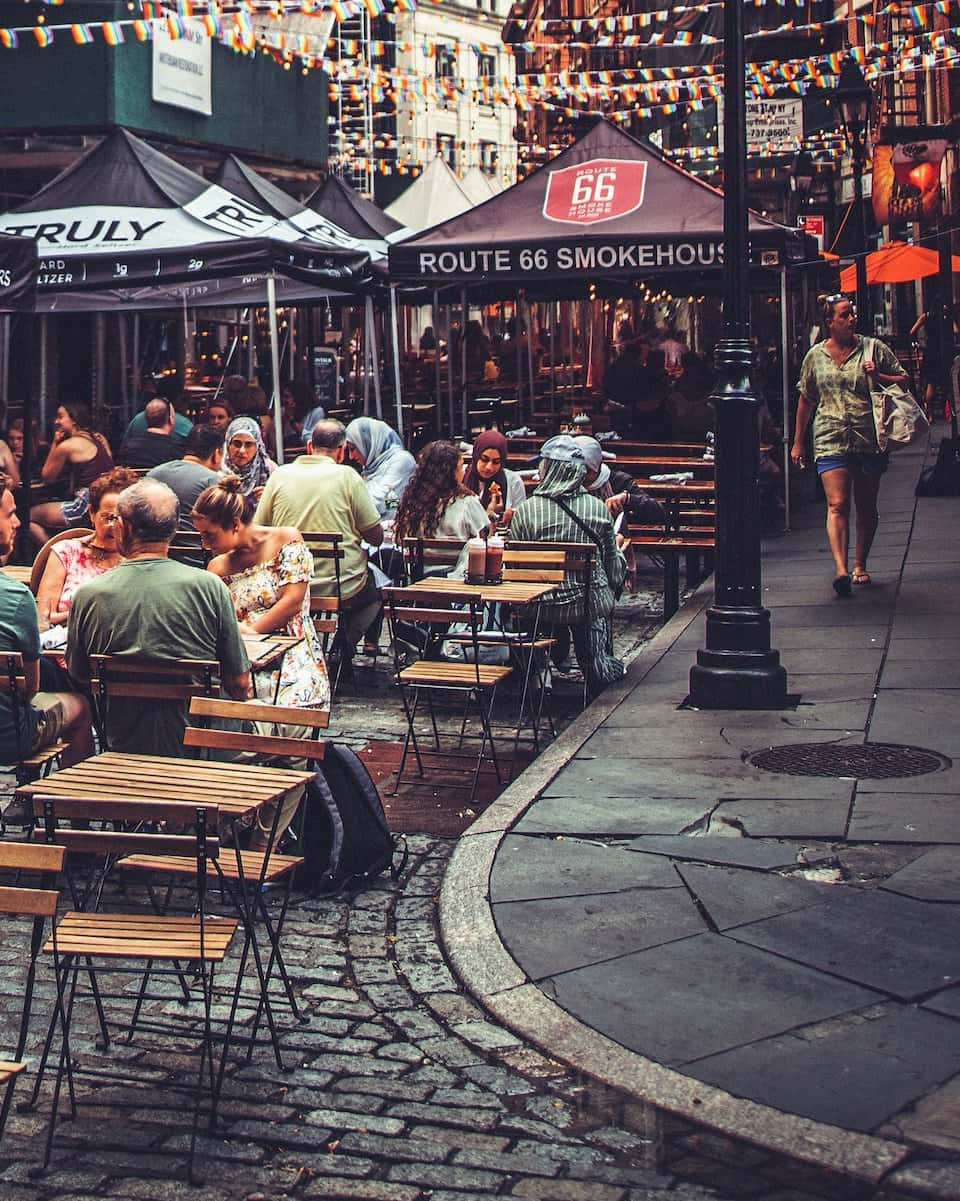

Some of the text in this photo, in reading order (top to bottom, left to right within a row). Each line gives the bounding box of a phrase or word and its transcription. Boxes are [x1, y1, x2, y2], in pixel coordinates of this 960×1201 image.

[571, 172, 617, 205] 66
[4, 221, 167, 244] TRULY
[419, 250, 512, 274] ROUTE
[519, 248, 549, 271] 66
